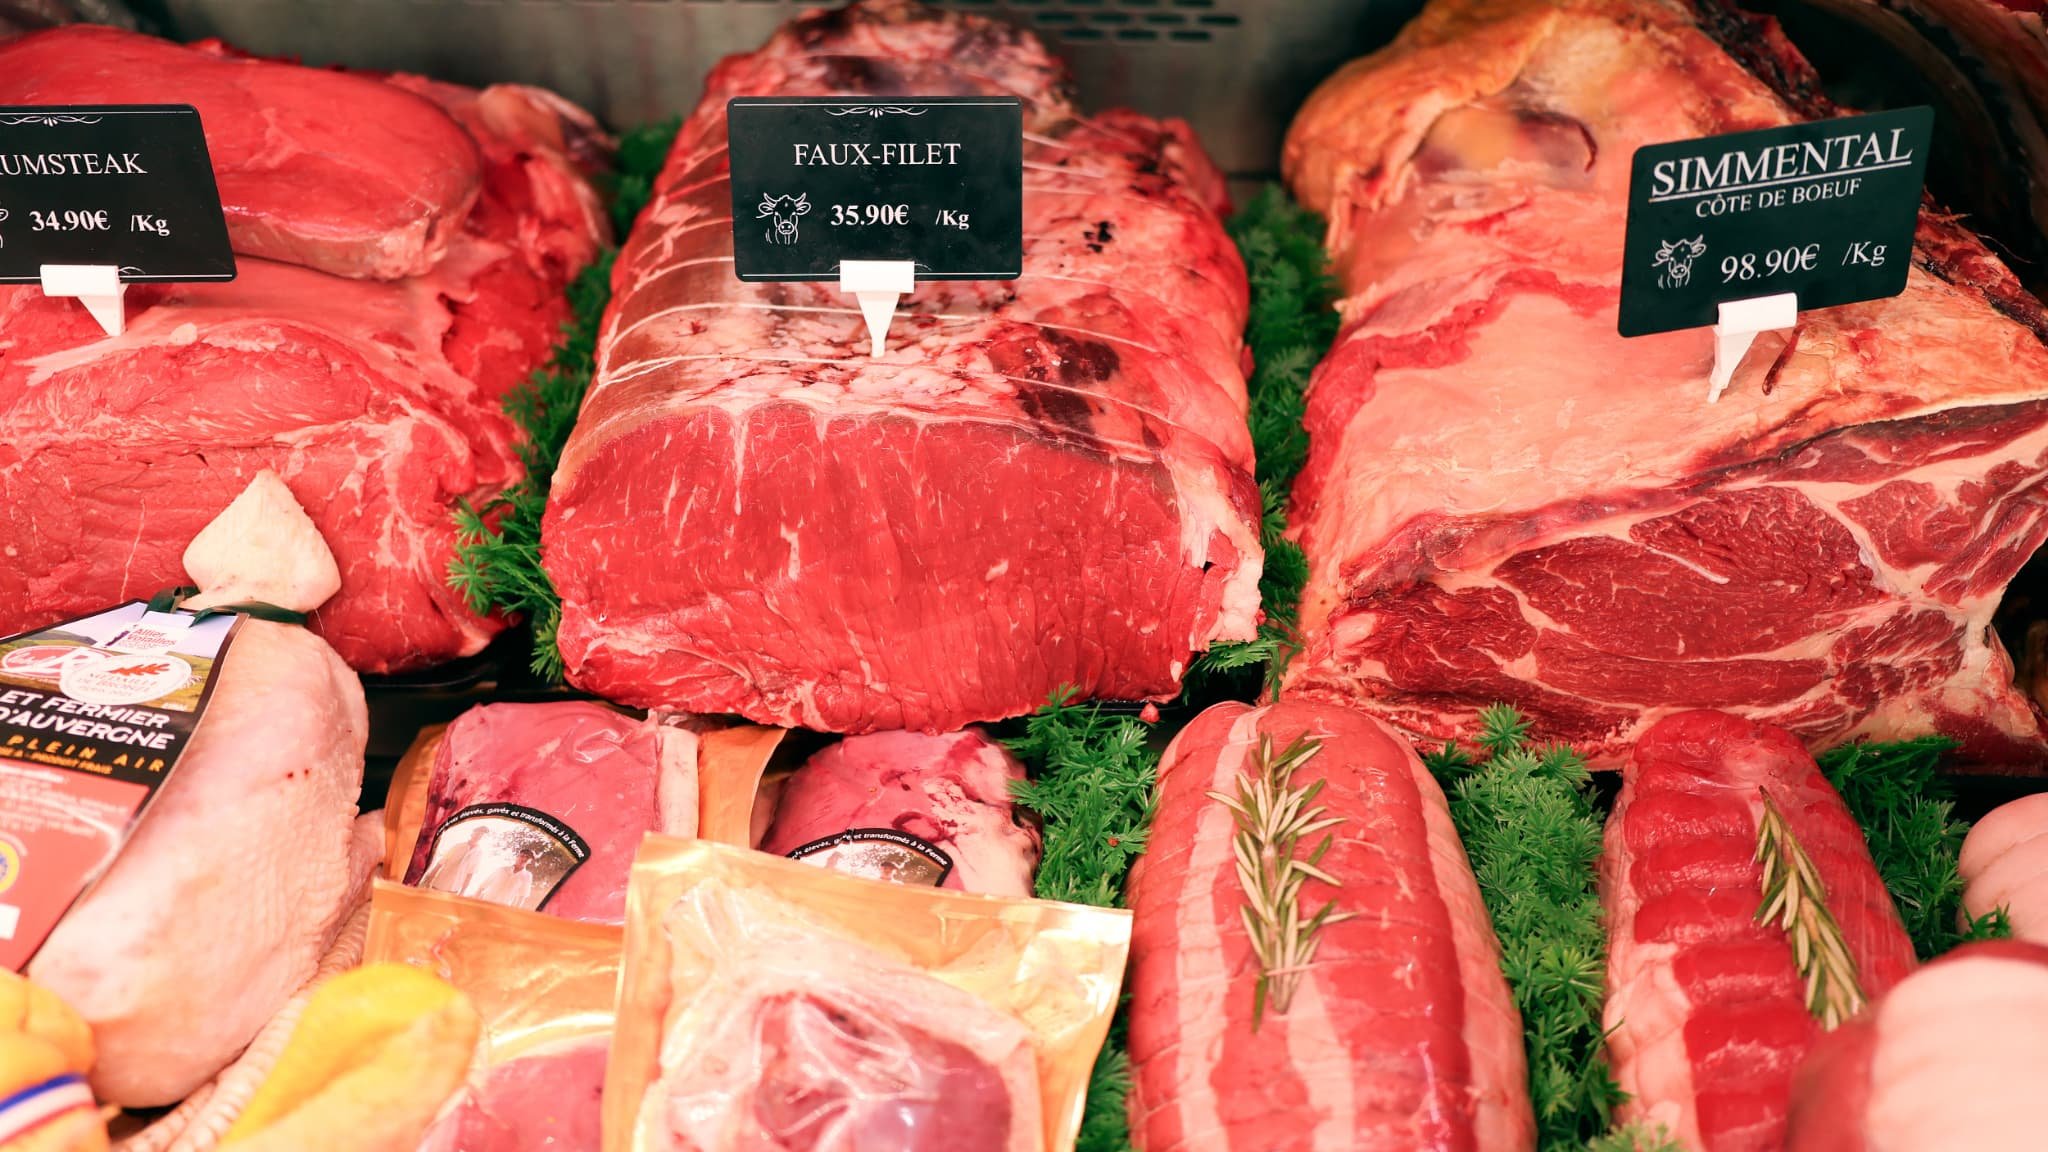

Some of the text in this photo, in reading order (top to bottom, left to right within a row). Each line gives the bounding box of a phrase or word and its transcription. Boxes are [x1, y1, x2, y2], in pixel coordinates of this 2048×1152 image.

[0, 153, 148, 176] UMSTEAK
[793, 143, 961, 166] FAUX-FILET
[1652, 128, 1913, 197] SIMMENTAL
[1695, 178, 1862, 218] CÔTE DE BOEUF
[29, 209, 170, 237] 34.90€ /Kg
[830, 204, 970, 230] 35.90€ /Kg
[1720, 241, 1887, 284] 98.90€ /Kg
[40, 696, 170, 728] FERMIER
[7, 735, 97, 759] PLEIN
[113, 754, 165, 772] AIR
[520, 812, 559, 834] transformés
[562, 834, 571, 842] la
[863, 833, 910, 845] transformés
[917, 843, 926, 851] la
[924, 848, 948, 866] Ferme
